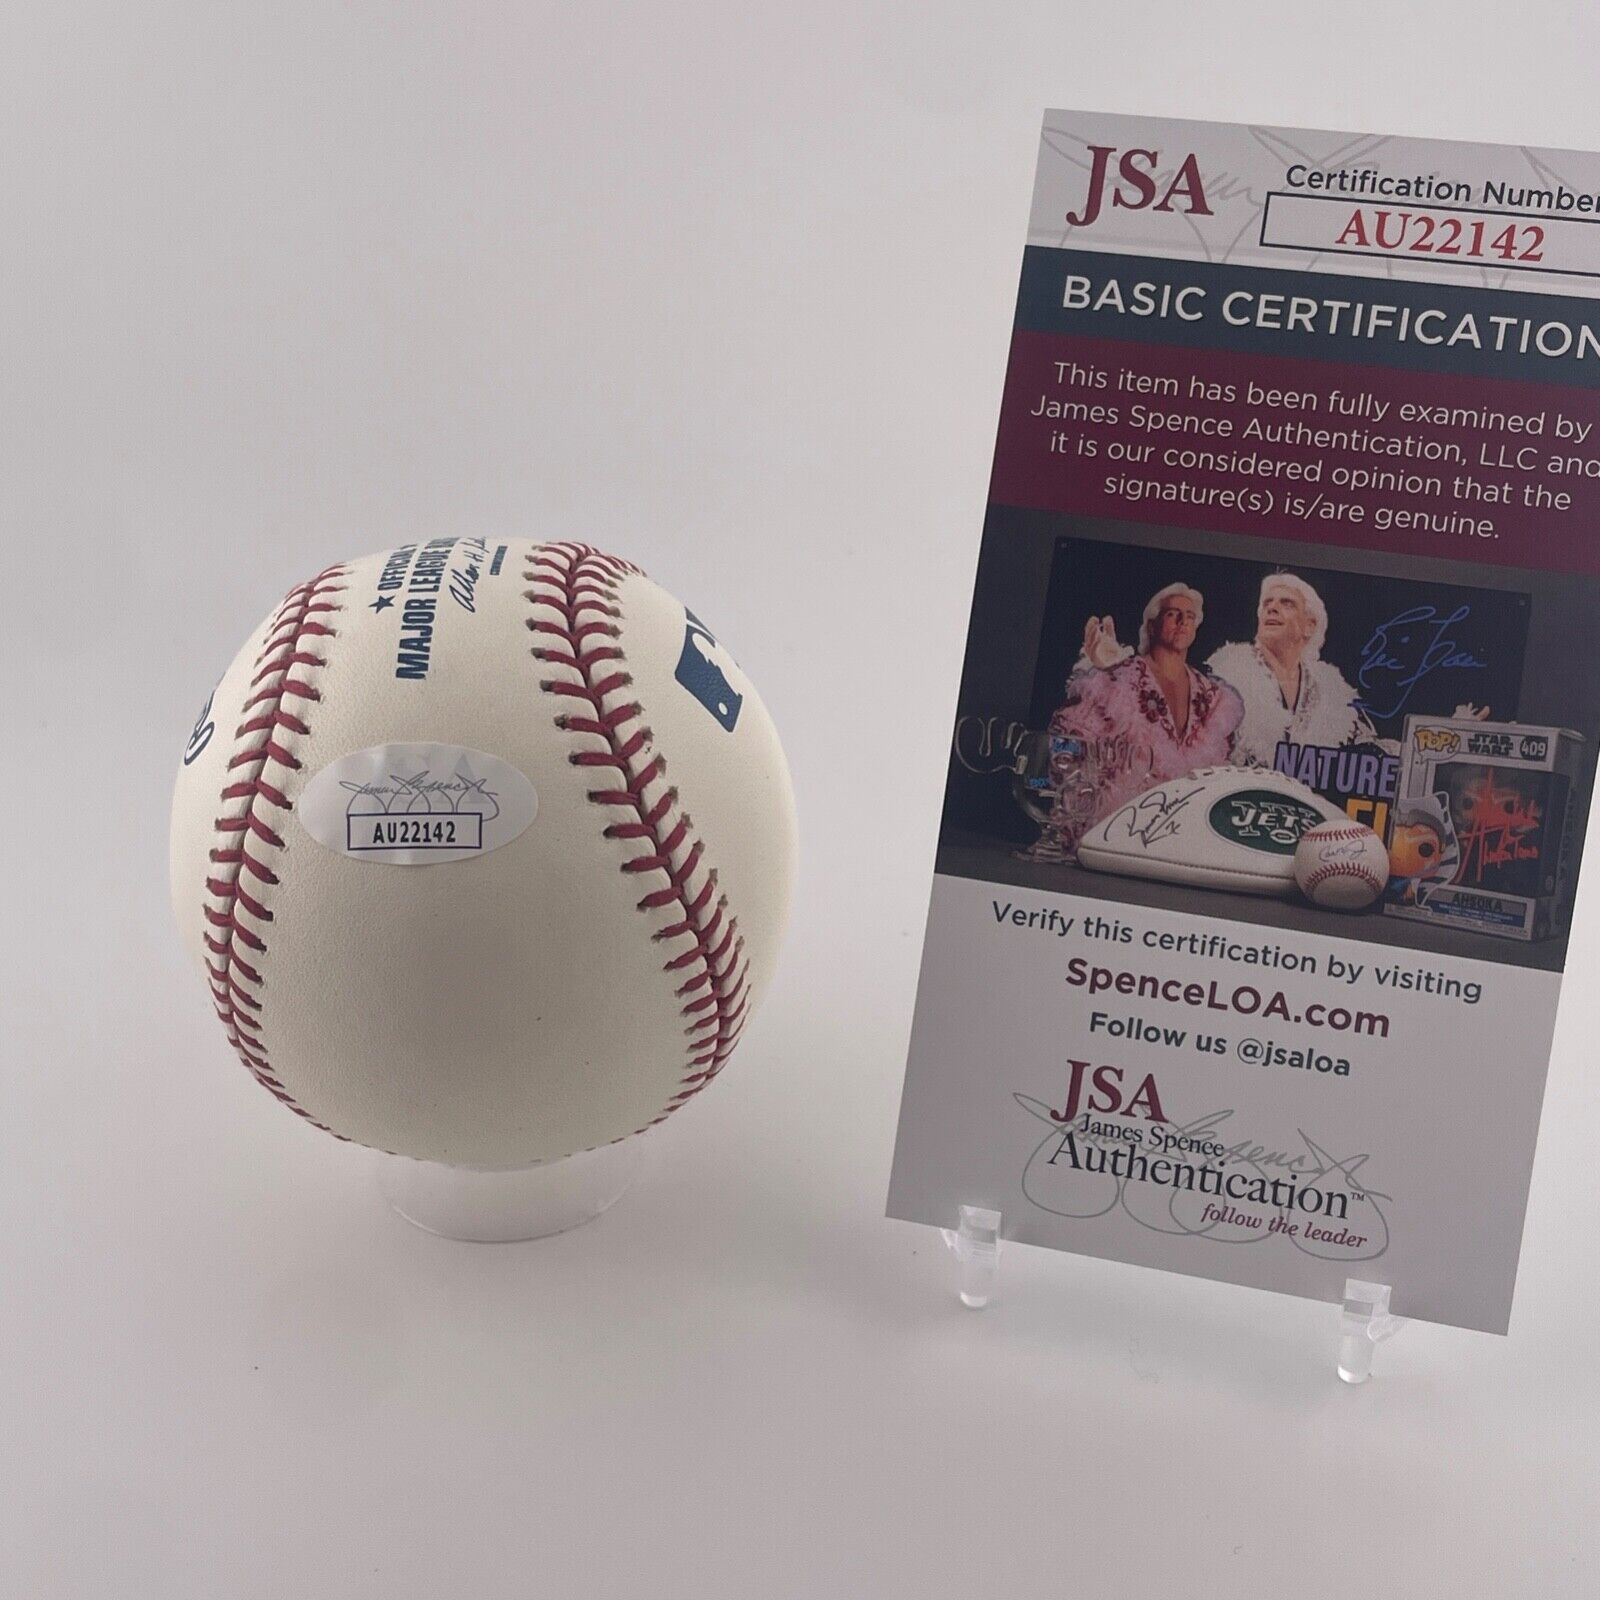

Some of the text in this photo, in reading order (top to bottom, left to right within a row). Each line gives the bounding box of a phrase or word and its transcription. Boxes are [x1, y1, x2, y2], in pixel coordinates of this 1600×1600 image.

[1066, 146, 1214, 227] JSA
[1285, 164, 1471, 202] Certification
[1335, 209, 1545, 263] AU22142
[1062, 275, 1600, 359] BASIC CERTIFICATION
[1030, 395, 1119, 425] James
[1129, 405, 1233, 439] Spence
[1242, 418, 1467, 466] Authentication,
[1479, 442, 1538, 470] LLC
[1054, 361, 1593, 443] This item has been fully examined by
[1050, 429, 1572, 511] it is our considered opinion that the
[1103, 473, 1499, 539] signature(s) is/are genuine.
[396, 598, 437, 680] MAJOR
[1276, 742, 1399, 799] NATURE
[1520, 741, 1547, 758] 409
[373, 820, 456, 844] AU22142
[992, 900, 1483, 1003] Verify this certification by visiting
[1066, 957, 1391, 1038] SpenceLOA.com
[1089, 1012, 1351, 1077] Follow us @jsaloa
[1050, 1060, 1168, 1123] JSA
[1079, 1114, 1143, 1144] James
[1148, 1126, 1225, 1157] Spence
[1201, 1203, 1367, 1251] follow the leader
